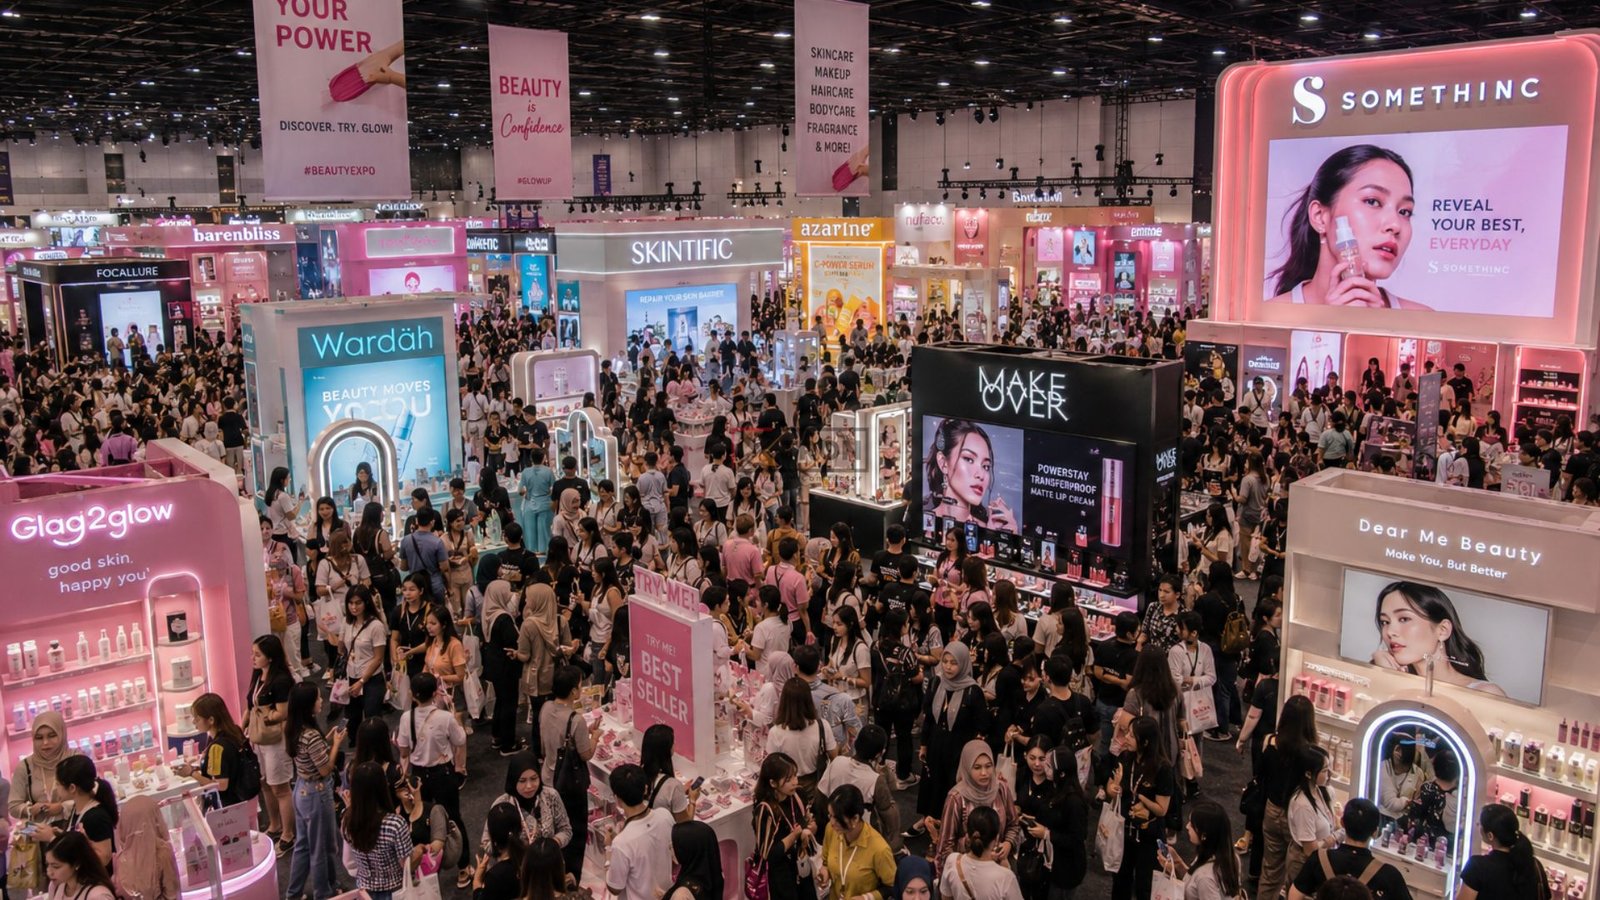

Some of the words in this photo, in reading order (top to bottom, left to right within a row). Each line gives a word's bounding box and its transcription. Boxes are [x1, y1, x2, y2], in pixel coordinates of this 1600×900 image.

[277, 0, 348, 21] YOUR
[276, 25, 372, 53] POWER
[811, 47, 854, 63] SKINCARE
[815, 66, 851, 80] MAKEUP
[499, 76, 562, 98] BEAUTY
[811, 85, 854, 99] HAIRCARE
[1341, 77, 1540, 111] SOMETHINC
[528, 100, 536, 112] is
[810, 103, 856, 118] BODYCARE
[280, 121, 334, 132] DISCOVER.
[337, 122, 359, 133] TRY.
[362, 123, 393, 134] GLOW!
[501, 113, 564, 141] Confidence
[807, 122, 858, 136] FRAGRANCE
[815, 142, 822, 152] &
[824, 142, 850, 153] MORE!
[304, 166, 376, 176] #BEAUTYEXPO
[517, 177, 552, 185] #GLOWUP
[1432, 199, 1494, 212] REVEAL
[193, 227, 281, 243] barenbliss
[1431, 218, 1476, 231] YOUR
[1481, 218, 1525, 234] BEST,
[632, 238, 734, 265] SKINTIFIC
[1430, 238, 1512, 251] EVERYDAY
[96, 267, 159, 279] FOCALLURE
[311, 324, 434, 360] Wardäh
[322, 386, 378, 402] BEAUTY
[383, 380, 431, 395] MOVES
[979, 366, 1066, 402] MAKE
[982, 383, 1069, 421] OVER
[1037, 463, 1089, 481] POWERSTAY
[1030, 487, 1054, 499] MATTE
[1055, 492, 1068, 501] LIP
[11, 503, 173, 546] Glag2glow
[1359, 518, 1408, 539] Dear
[1419, 529, 1448, 546] Me
[1460, 536, 1542, 566] Beauty
[48, 558, 92, 579] good
[98, 553, 134, 568] skin.
[1385, 548, 1416, 562] Make
[1419, 554, 1443, 568] You,
[1447, 559, 1466, 572] But
[1470, 563, 1508, 580] Better
[60, 576, 112, 593] happy
[635, 571, 662, 597] TRY
[667, 580, 696, 612] ME!
[646, 634, 661, 648] TRY
[661, 641, 676, 657] ME!
[641, 650, 682, 691] BEST
[636, 677, 689, 725] SELLER
